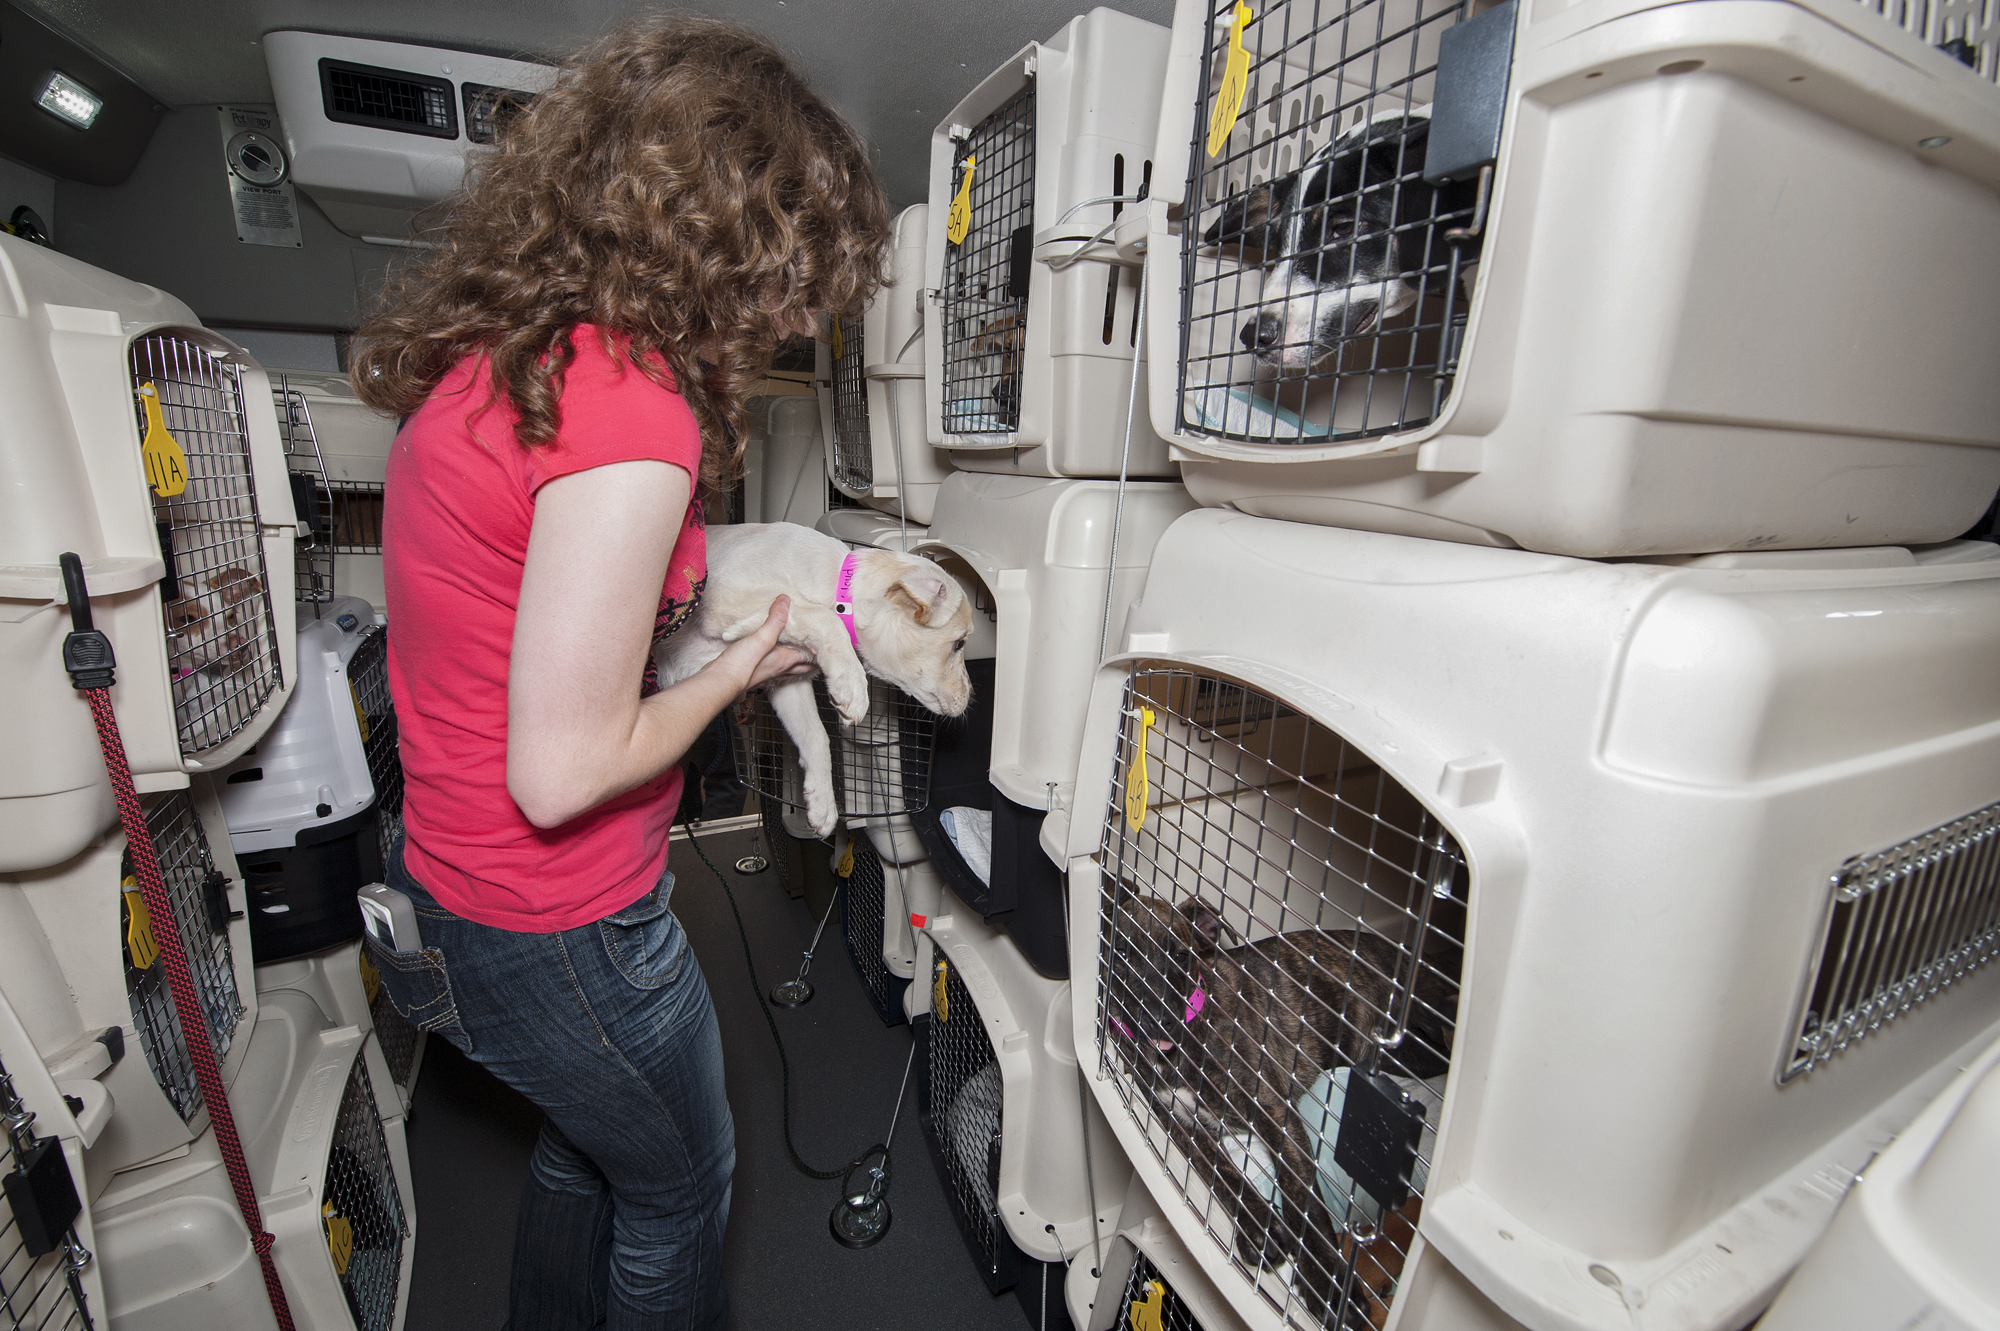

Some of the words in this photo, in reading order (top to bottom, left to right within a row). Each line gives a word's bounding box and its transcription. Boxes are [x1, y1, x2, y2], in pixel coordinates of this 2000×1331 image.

[1213, 75, 1236, 150] 4A
[947, 203, 963, 237] 5A
[149, 452, 184, 490] 11A
[841, 568, 853, 600] loud
[1129, 773, 1143, 821] 4B
[839, 855, 852, 873] 6C
[935, 987, 946, 1015] 5C
[333, 1226, 350, 1271] 11C
